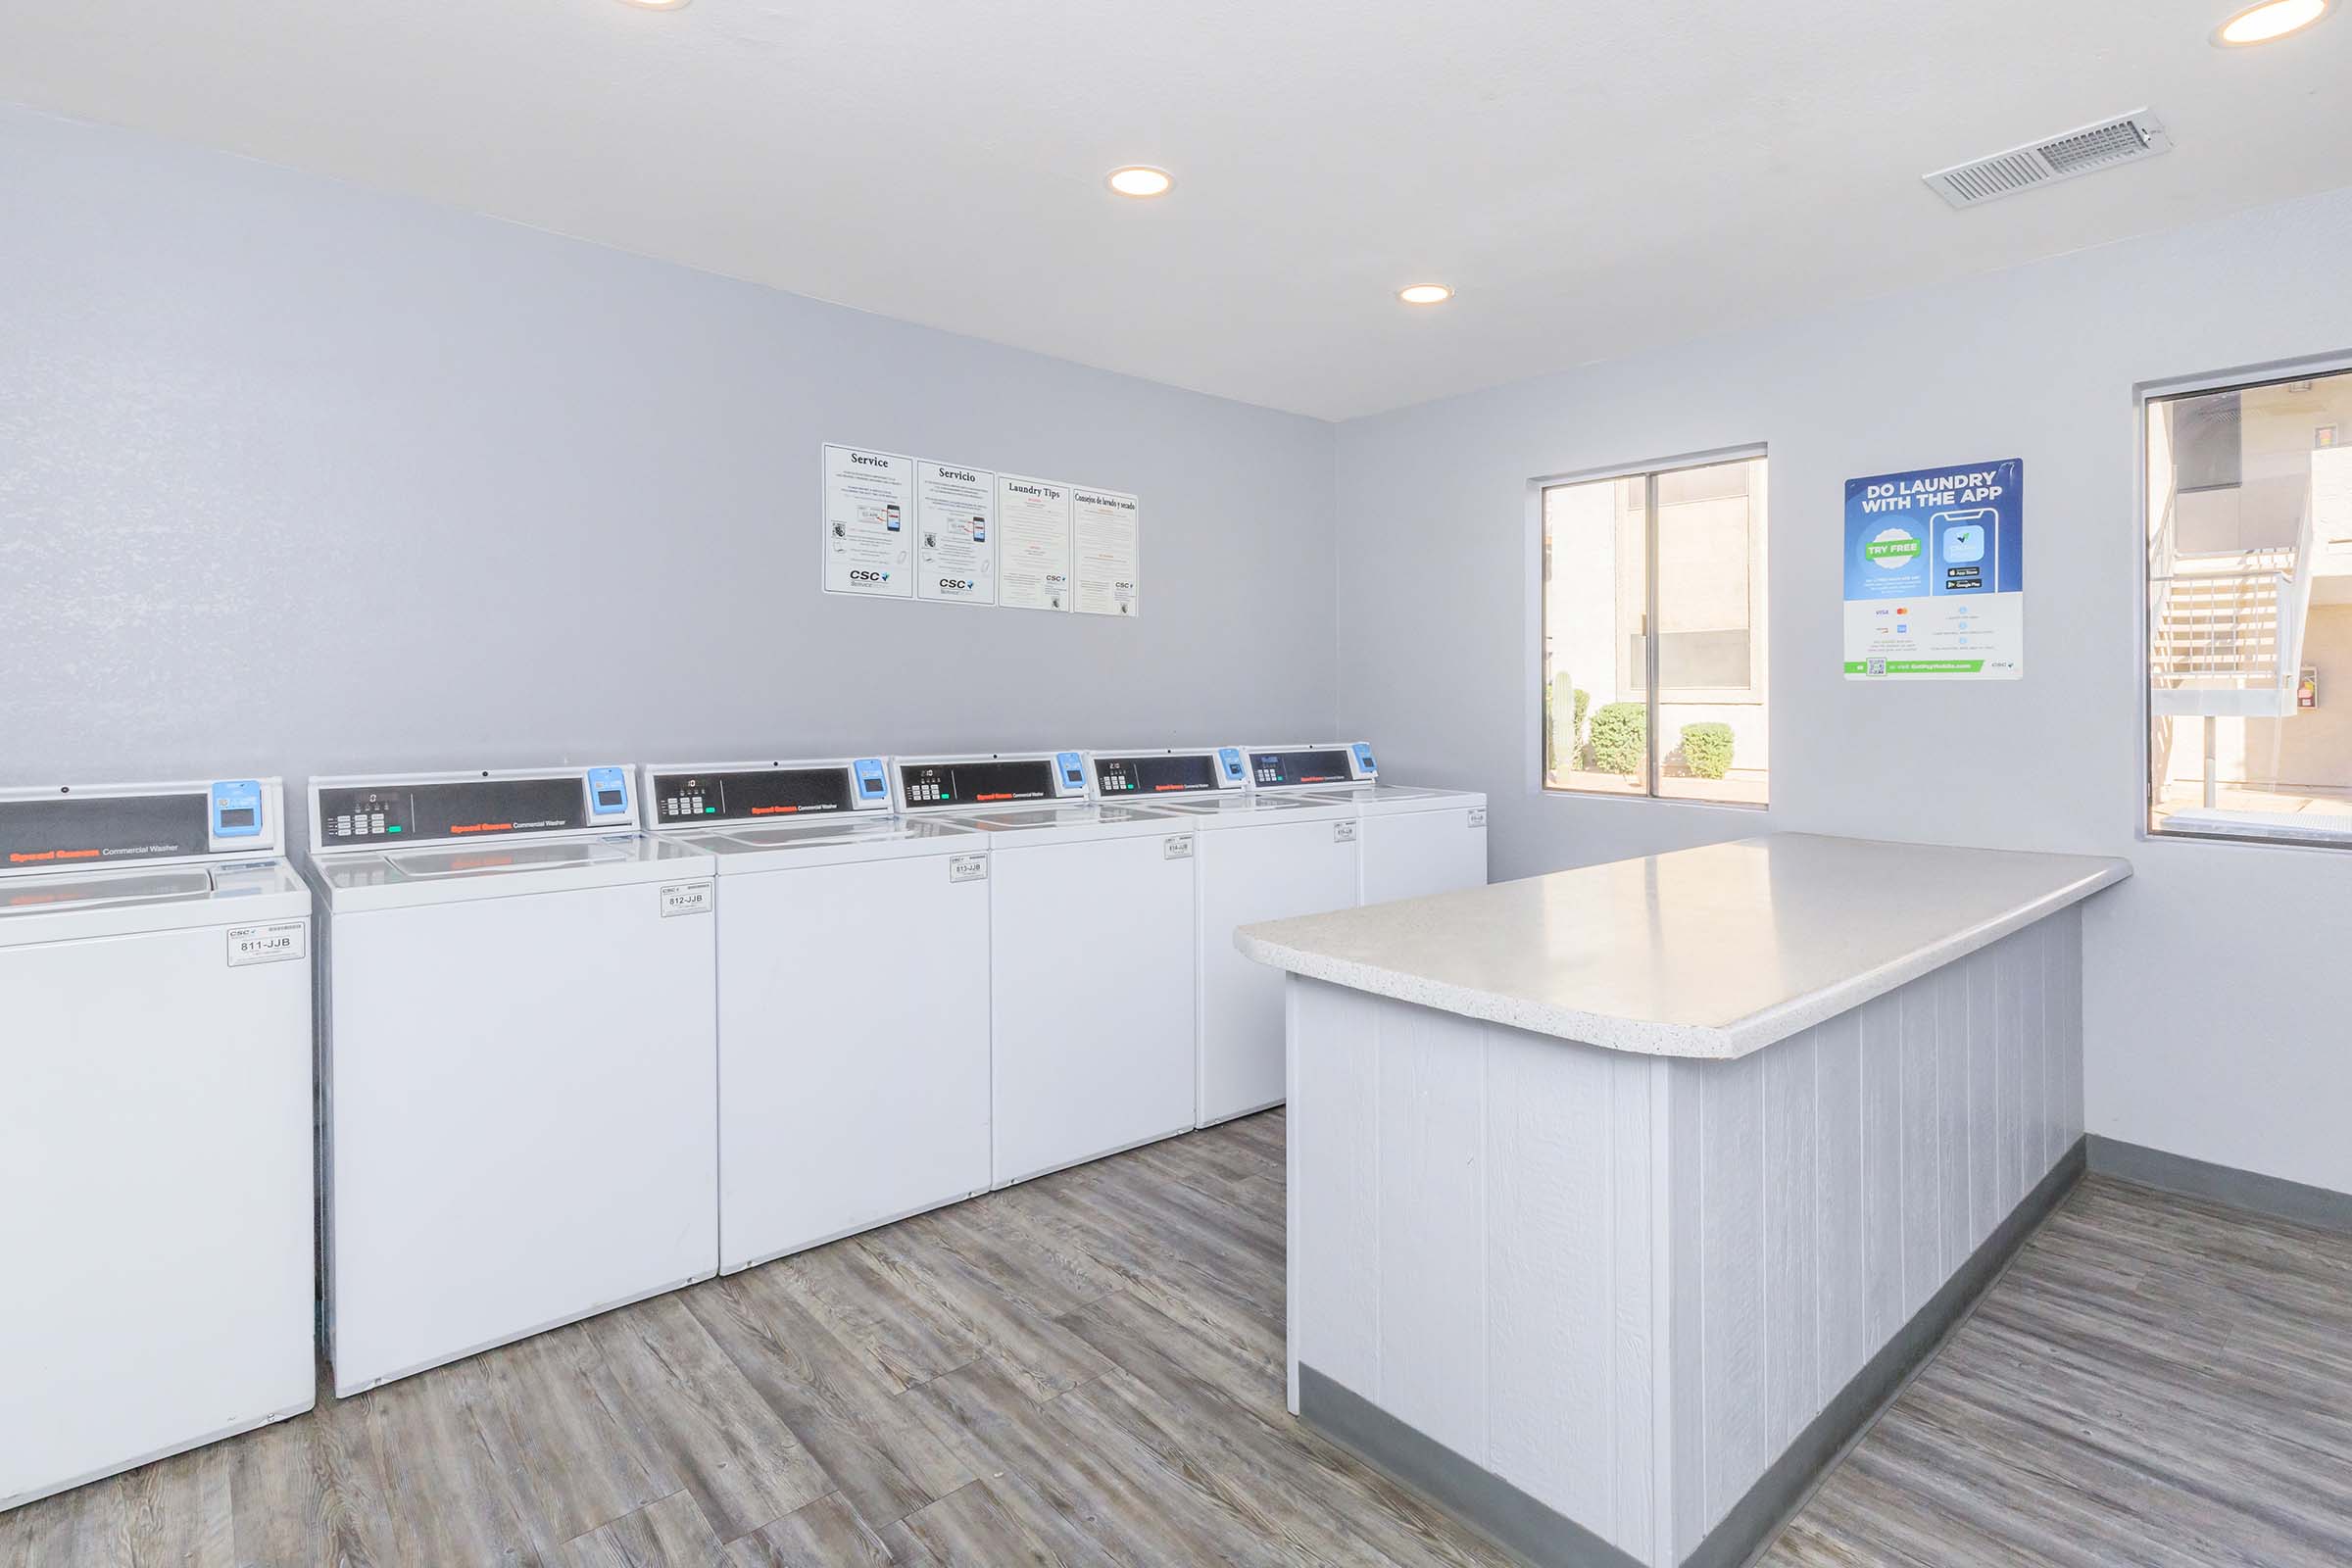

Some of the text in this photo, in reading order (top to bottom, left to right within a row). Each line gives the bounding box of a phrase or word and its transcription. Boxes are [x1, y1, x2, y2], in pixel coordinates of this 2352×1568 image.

[851, 453, 889, 467] Service
[939, 467, 976, 482] Servicio
[1008, 482, 1060, 500] Laundry Tips
[1867, 470, 1997, 499] DO LAUNDRY
[1862, 486, 2003, 514] WITH THE APP
[1868, 543, 1918, 555] TRY FREE
[850, 570, 880, 581] CSC
[939, 578, 966, 589] CSC
[102, 846, 149, 856] Commercial
[149, 844, 178, 853] Washer
[669, 895, 703, 905] 812-JJB
[241, 938, 291, 952] 811-JJB
